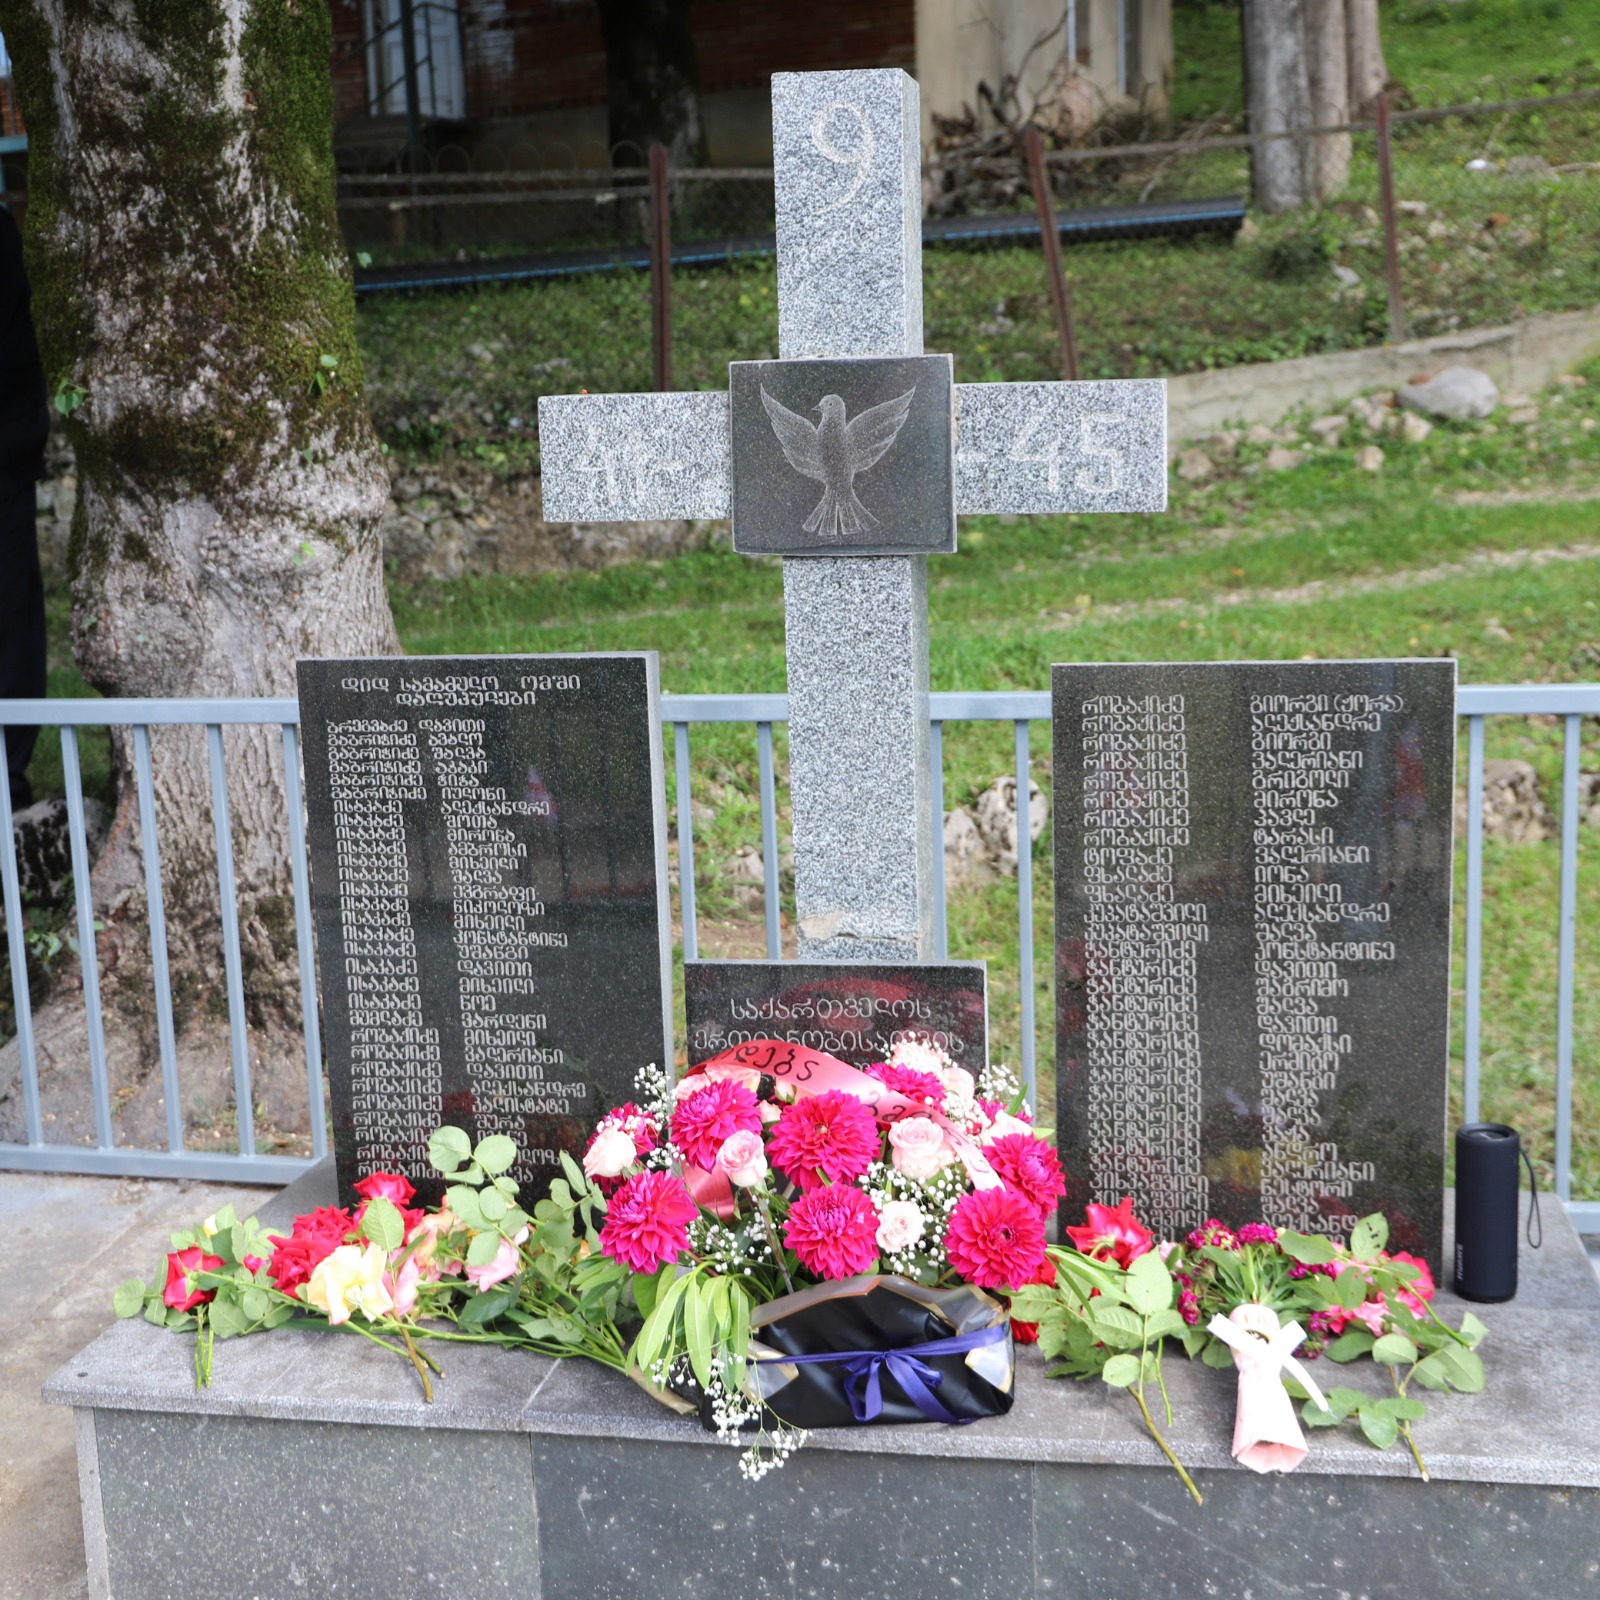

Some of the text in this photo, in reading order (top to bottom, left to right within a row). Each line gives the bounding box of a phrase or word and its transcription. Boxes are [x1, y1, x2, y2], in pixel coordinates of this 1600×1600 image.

[810, 100, 875, 213] 9
[341, 674, 581, 692] დიდ სამამულო ომში
[395, 691, 536, 706] დაღუპულები
[1082, 694, 1404, 714] რობაქიძე გიორგი (ჟორა)
[326, 718, 486, 733] ბრეგვაძე დავითი
[1082, 712, 1381, 732] რობაქიძე ალექსანდრე
[328, 732, 482, 746] გაბრიჭიძე ავალო
[1083, 731, 1332, 751] რობაქიძე გიორგი
[328, 746, 486, 760] გაბრიჭიძე შალვა
[1083, 750, 1363, 770] რობაქიძე ვალერიანი
[329, 760, 488, 774] გაბრიჭიძე აკაკი
[330, 773, 480, 787] გაბრიჭიძე ჭიჭა
[1083, 769, 1349, 790] რობაქიძე გრიგოლი
[331, 786, 506, 800] გაბრიჭიძე იულონი
[1084, 788, 1339, 808] რობაქიძე მირონა
[334, 800, 550, 815] ისაკაძე ალექსანდრე
[1084, 808, 1316, 827] რობაქიძე პავლე
[334, 813, 498, 828] ისაკაძე შოთა
[336, 826, 516, 842] ისაკაძე მირონა
[1083, 826, 1334, 846] რობაქიძე ტარასი
[337, 840, 528, 857] ისაკაძე ამბროსი
[1083, 845, 1370, 866] ტოფაძე ვალერიანი
[338, 854, 519, 870] ისაკაძე მიხეილი
[339, 867, 503, 884] ისაკაძე შალვა
[1083, 864, 1309, 884] ფხალაძე იონა
[340, 881, 536, 901] ისაკაძე ევგრაფი
[1084, 883, 1342, 903] ფხალაძე მიხეილი
[340, 896, 545, 916] ისაკაძე ნიკოლოზი
[1083, 902, 1390, 923] კუპატაშვილი ალექსანდრე
[341, 911, 526, 931] ისაკაძე მიხეილი
[343, 925, 569, 947] ისაკაძე კონსტანტინე
[1084, 922, 1317, 942] კუპატაშვილი შალვა
[344, 941, 529, 959] ისაკაძე უშანგი
[1085, 940, 1395, 960] ჭანტურიძე კონსტანტინე
[345, 957, 533, 977] ისაკაძე დავითი
[1086, 959, 1337, 979] ჭანტურიძე დავითი
[347, 975, 535, 994] ისაკაძე მიხეილი
[1086, 976, 1197, 995] ჭანტურიძე
[348, 993, 497, 1011] ისაკაძე ნოე
[730, 997, 932, 1020] საქართველოს
[1086, 994, 1319, 1015] ჭანტურიძე შალვა
[349, 1009, 547, 1029] მუმლაძე ვარდენი
[1086, 1011, 1338, 1034] ჭანტურიძე დავითი
[351, 1027, 536, 1046] რობაქიძე მიხეილი
[1086, 1030, 1200, 1050] ჭანტურიძე
[350, 1043, 564, 1064] რობაქიძე ვალერიანი
[1088, 1049, 1201, 1068] ჭანტურიძე
[351, 1061, 544, 1079] რობაქიძე დავითი
[1088, 1067, 1336, 1090] ჭანტურიძე უშანგი
[352, 1077, 586, 1098] რობაქიძე ალექსანდრე
[1088, 1084, 1319, 1107] ჭანტურიძე შალვა
[352, 1094, 570, 1114] რობაქიძე კალისტატე
[353, 1111, 526, 1130] რობაქიძე შურა
[1087, 1103, 1321, 1126] ჭანტურიძე შალვა
[1087, 1120, 1310, 1143] ჭანტურიძე ვაჟა
[356, 1143, 430, 1160] რობაქი
[1088, 1138, 1338, 1161] ჭანტურიძე ანდრო
[1089, 1155, 1375, 1181] ჭანტურიძე ვალერიანი
[1260, 1179, 1353, 1197] ნესტორი
[1260, 1195, 1320, 1214] შალვა
